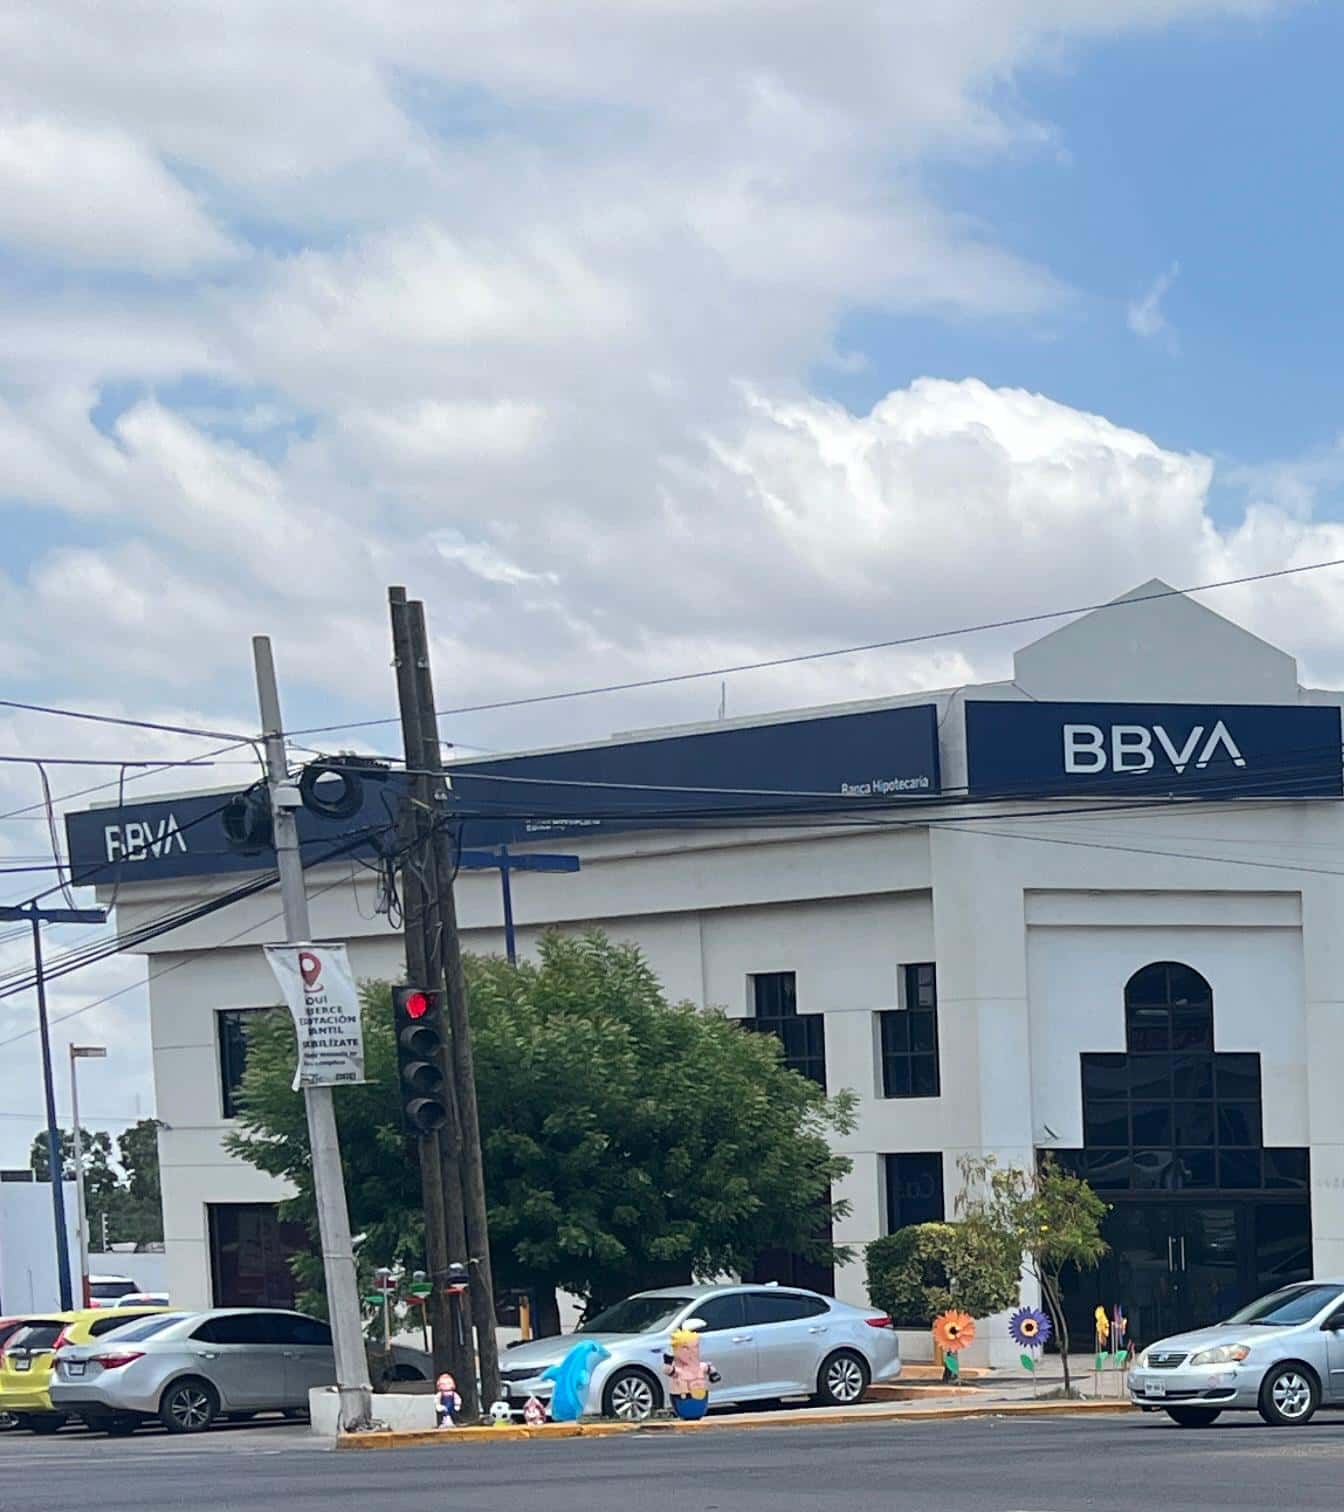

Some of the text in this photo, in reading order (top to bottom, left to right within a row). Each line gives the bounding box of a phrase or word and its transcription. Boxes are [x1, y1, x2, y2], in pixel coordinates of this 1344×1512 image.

[1063, 719, 1247, 774] BBVA
[872, 775, 929, 795] Hipotecaria
[104, 813, 187, 863] BBVA
